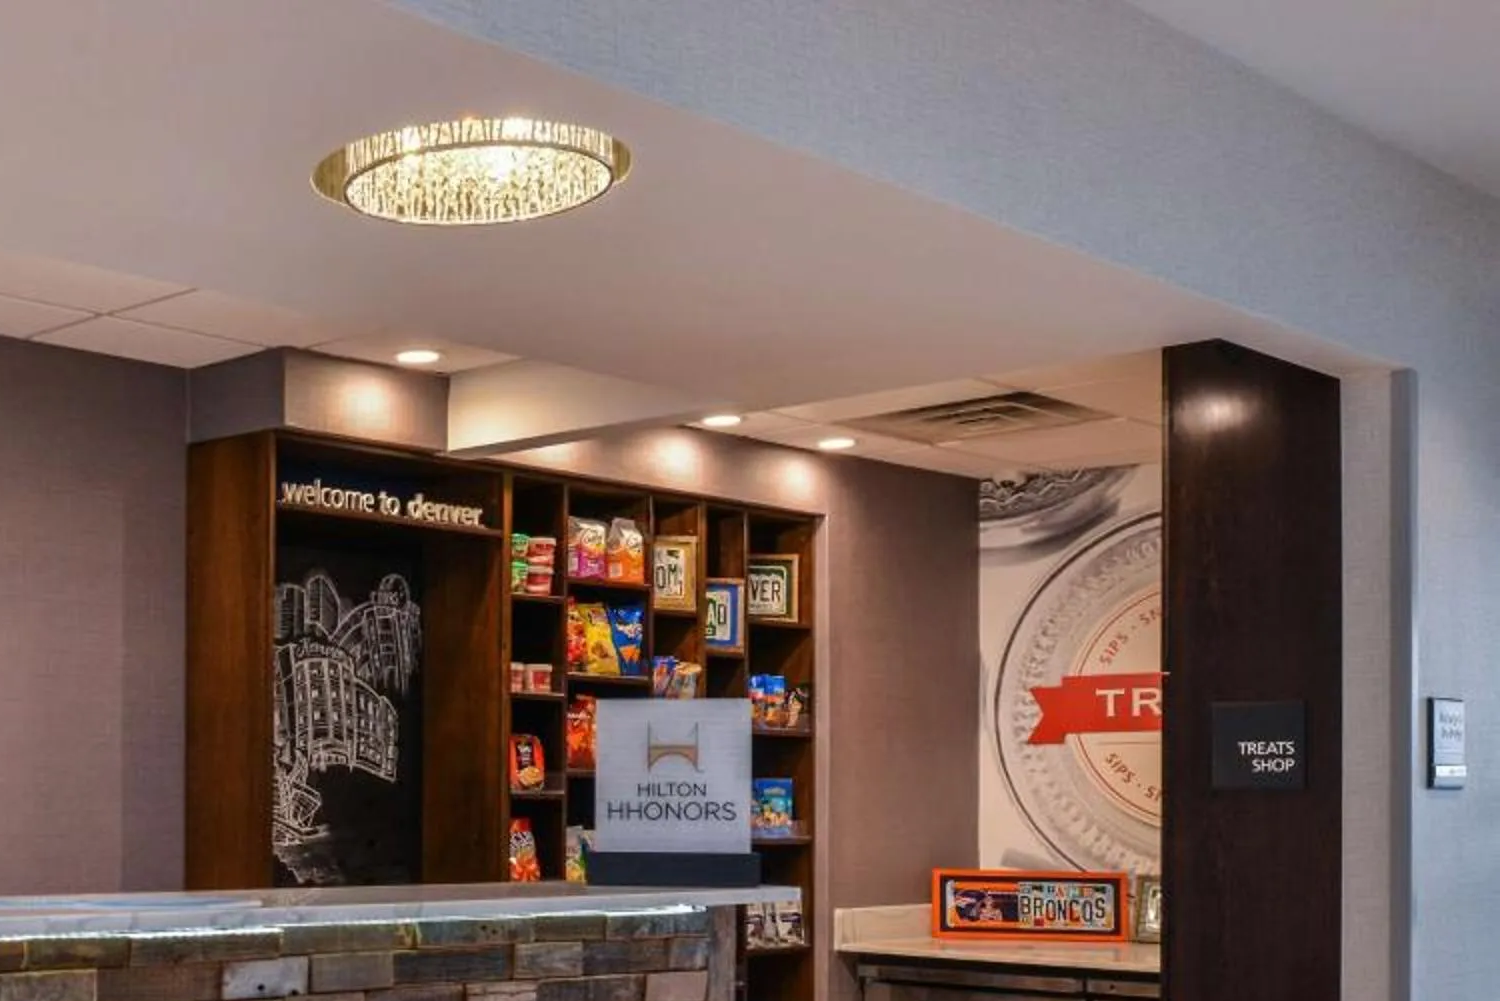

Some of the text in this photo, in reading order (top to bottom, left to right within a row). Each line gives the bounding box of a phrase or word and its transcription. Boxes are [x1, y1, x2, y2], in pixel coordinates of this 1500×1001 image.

[281, 478, 375, 514] welcome
[379, 491, 400, 516] to
[1100, 631, 1130, 666] SIPS
[1237, 740, 1295, 755] TREATS
[1105, 752, 1136, 785] SIPS
[1251, 758, 1295, 773] SHOP
[637, 782, 707, 798] HILTON
[607, 801, 738, 821] HHONORS
[1019, 895, 1106, 922] BRONCOS
